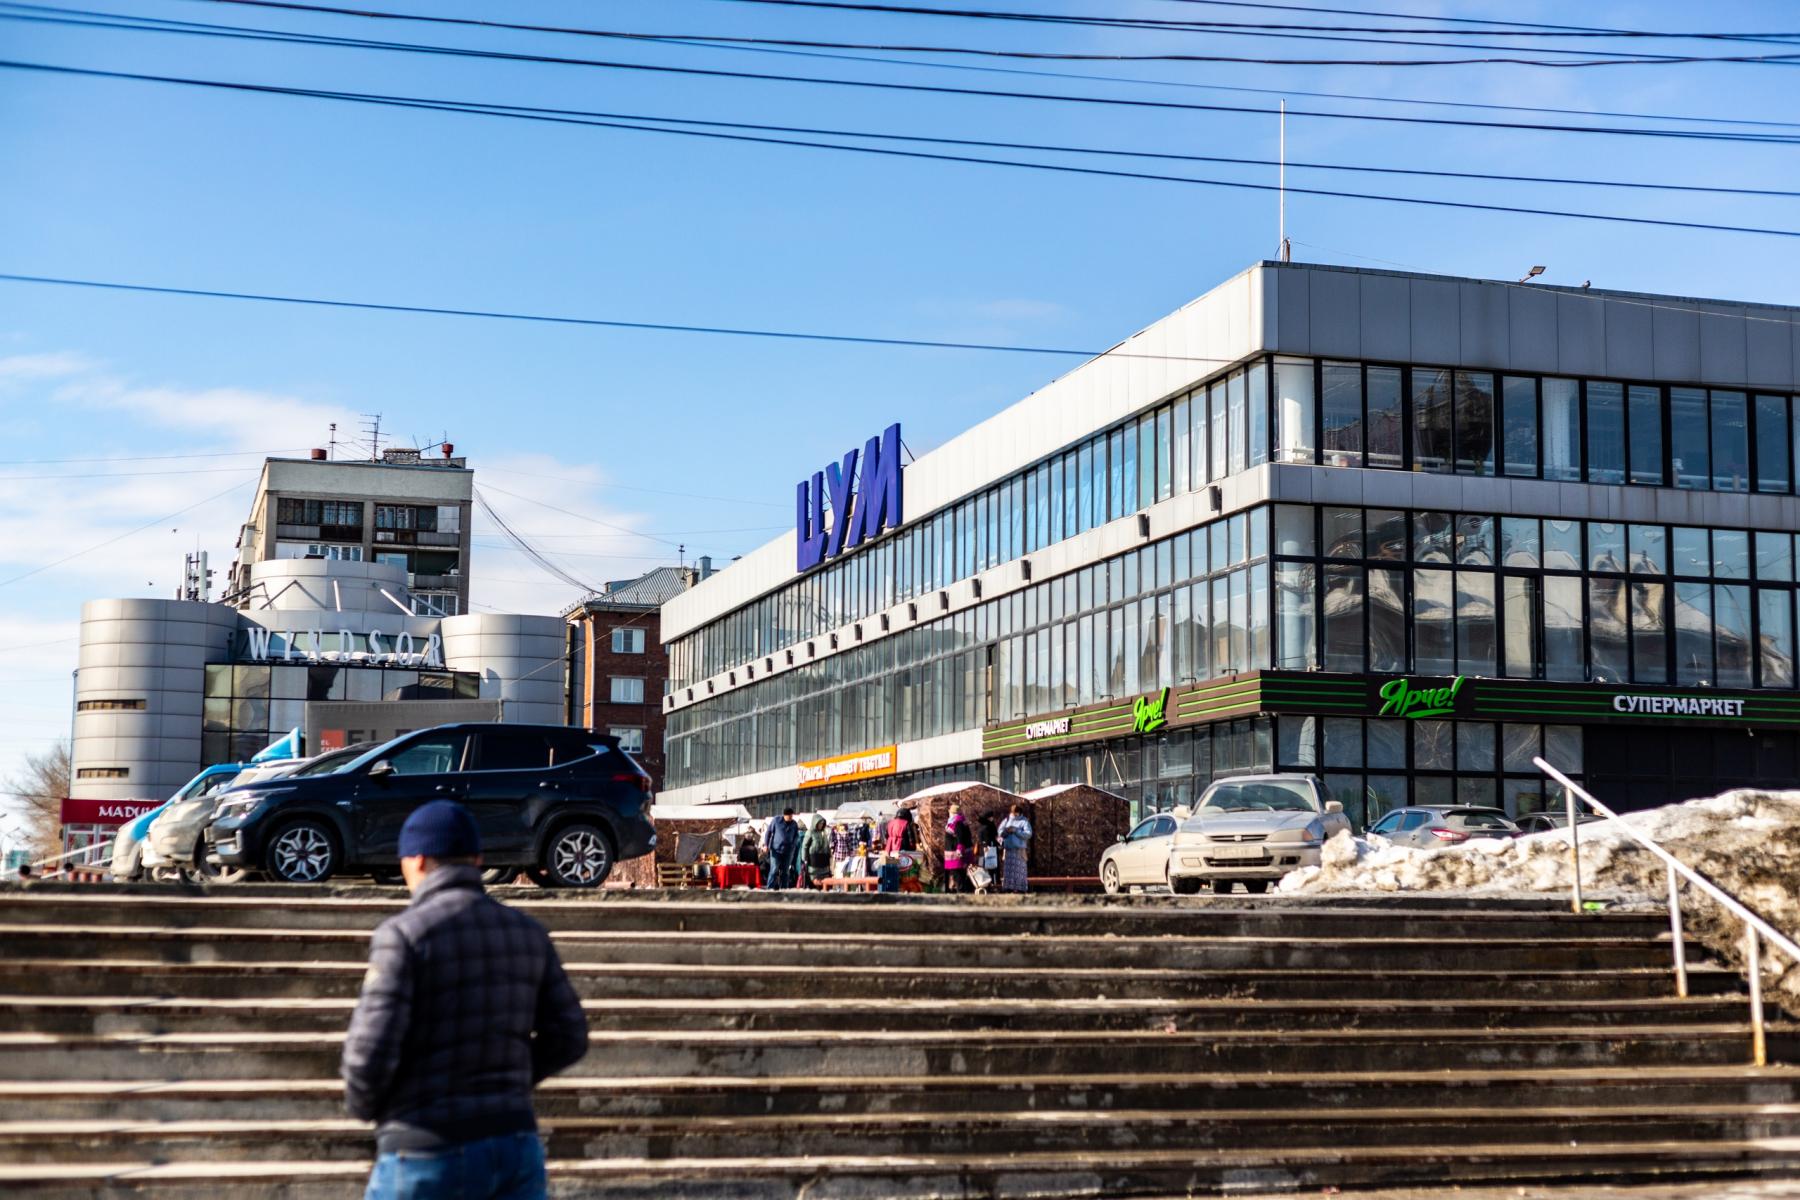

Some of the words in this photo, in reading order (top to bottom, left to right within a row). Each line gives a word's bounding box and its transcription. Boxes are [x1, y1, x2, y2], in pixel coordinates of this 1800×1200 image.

[797, 423, 902, 573] ЦУМ
[248, 627, 445, 667] WINDSOR
[1132, 687, 1169, 733] Ярче!
[1379, 674, 1465, 718] Ярче!
[1613, 695, 1745, 716] СУПЕРМАРКЕТ
[1025, 717, 1071, 739] СУПЕРМАРКЕТ
